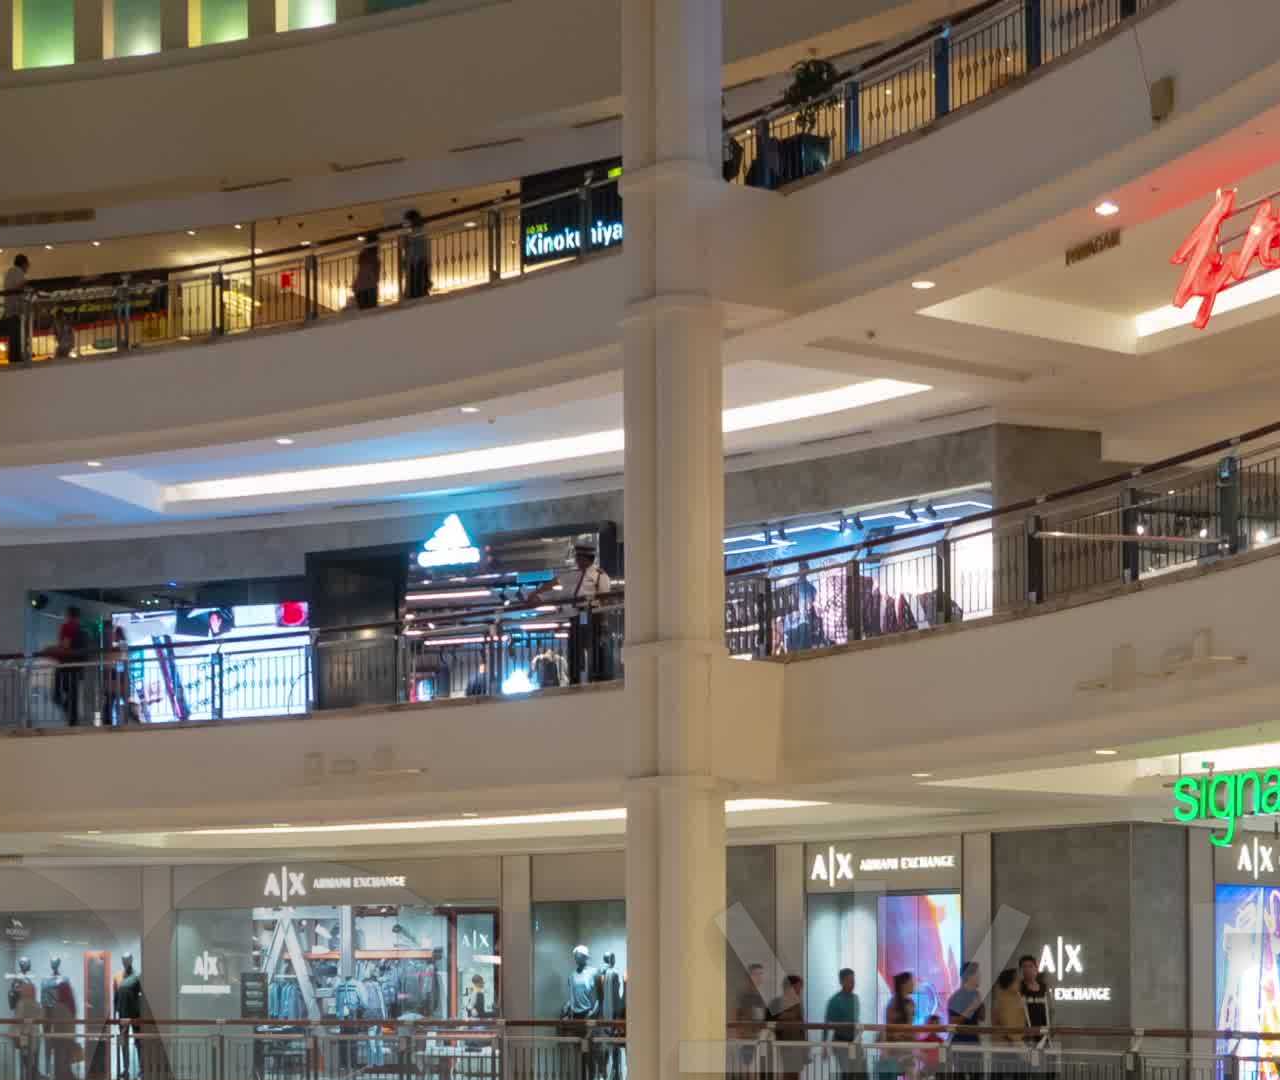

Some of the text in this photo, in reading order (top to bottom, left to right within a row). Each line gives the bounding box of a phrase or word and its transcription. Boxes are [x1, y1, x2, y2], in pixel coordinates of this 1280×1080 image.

[900, 855, 956, 869] EXCHANGE
[353, 875, 407, 888] EXCHANGE
[1054, 987, 1111, 1001] EXCHANGE
